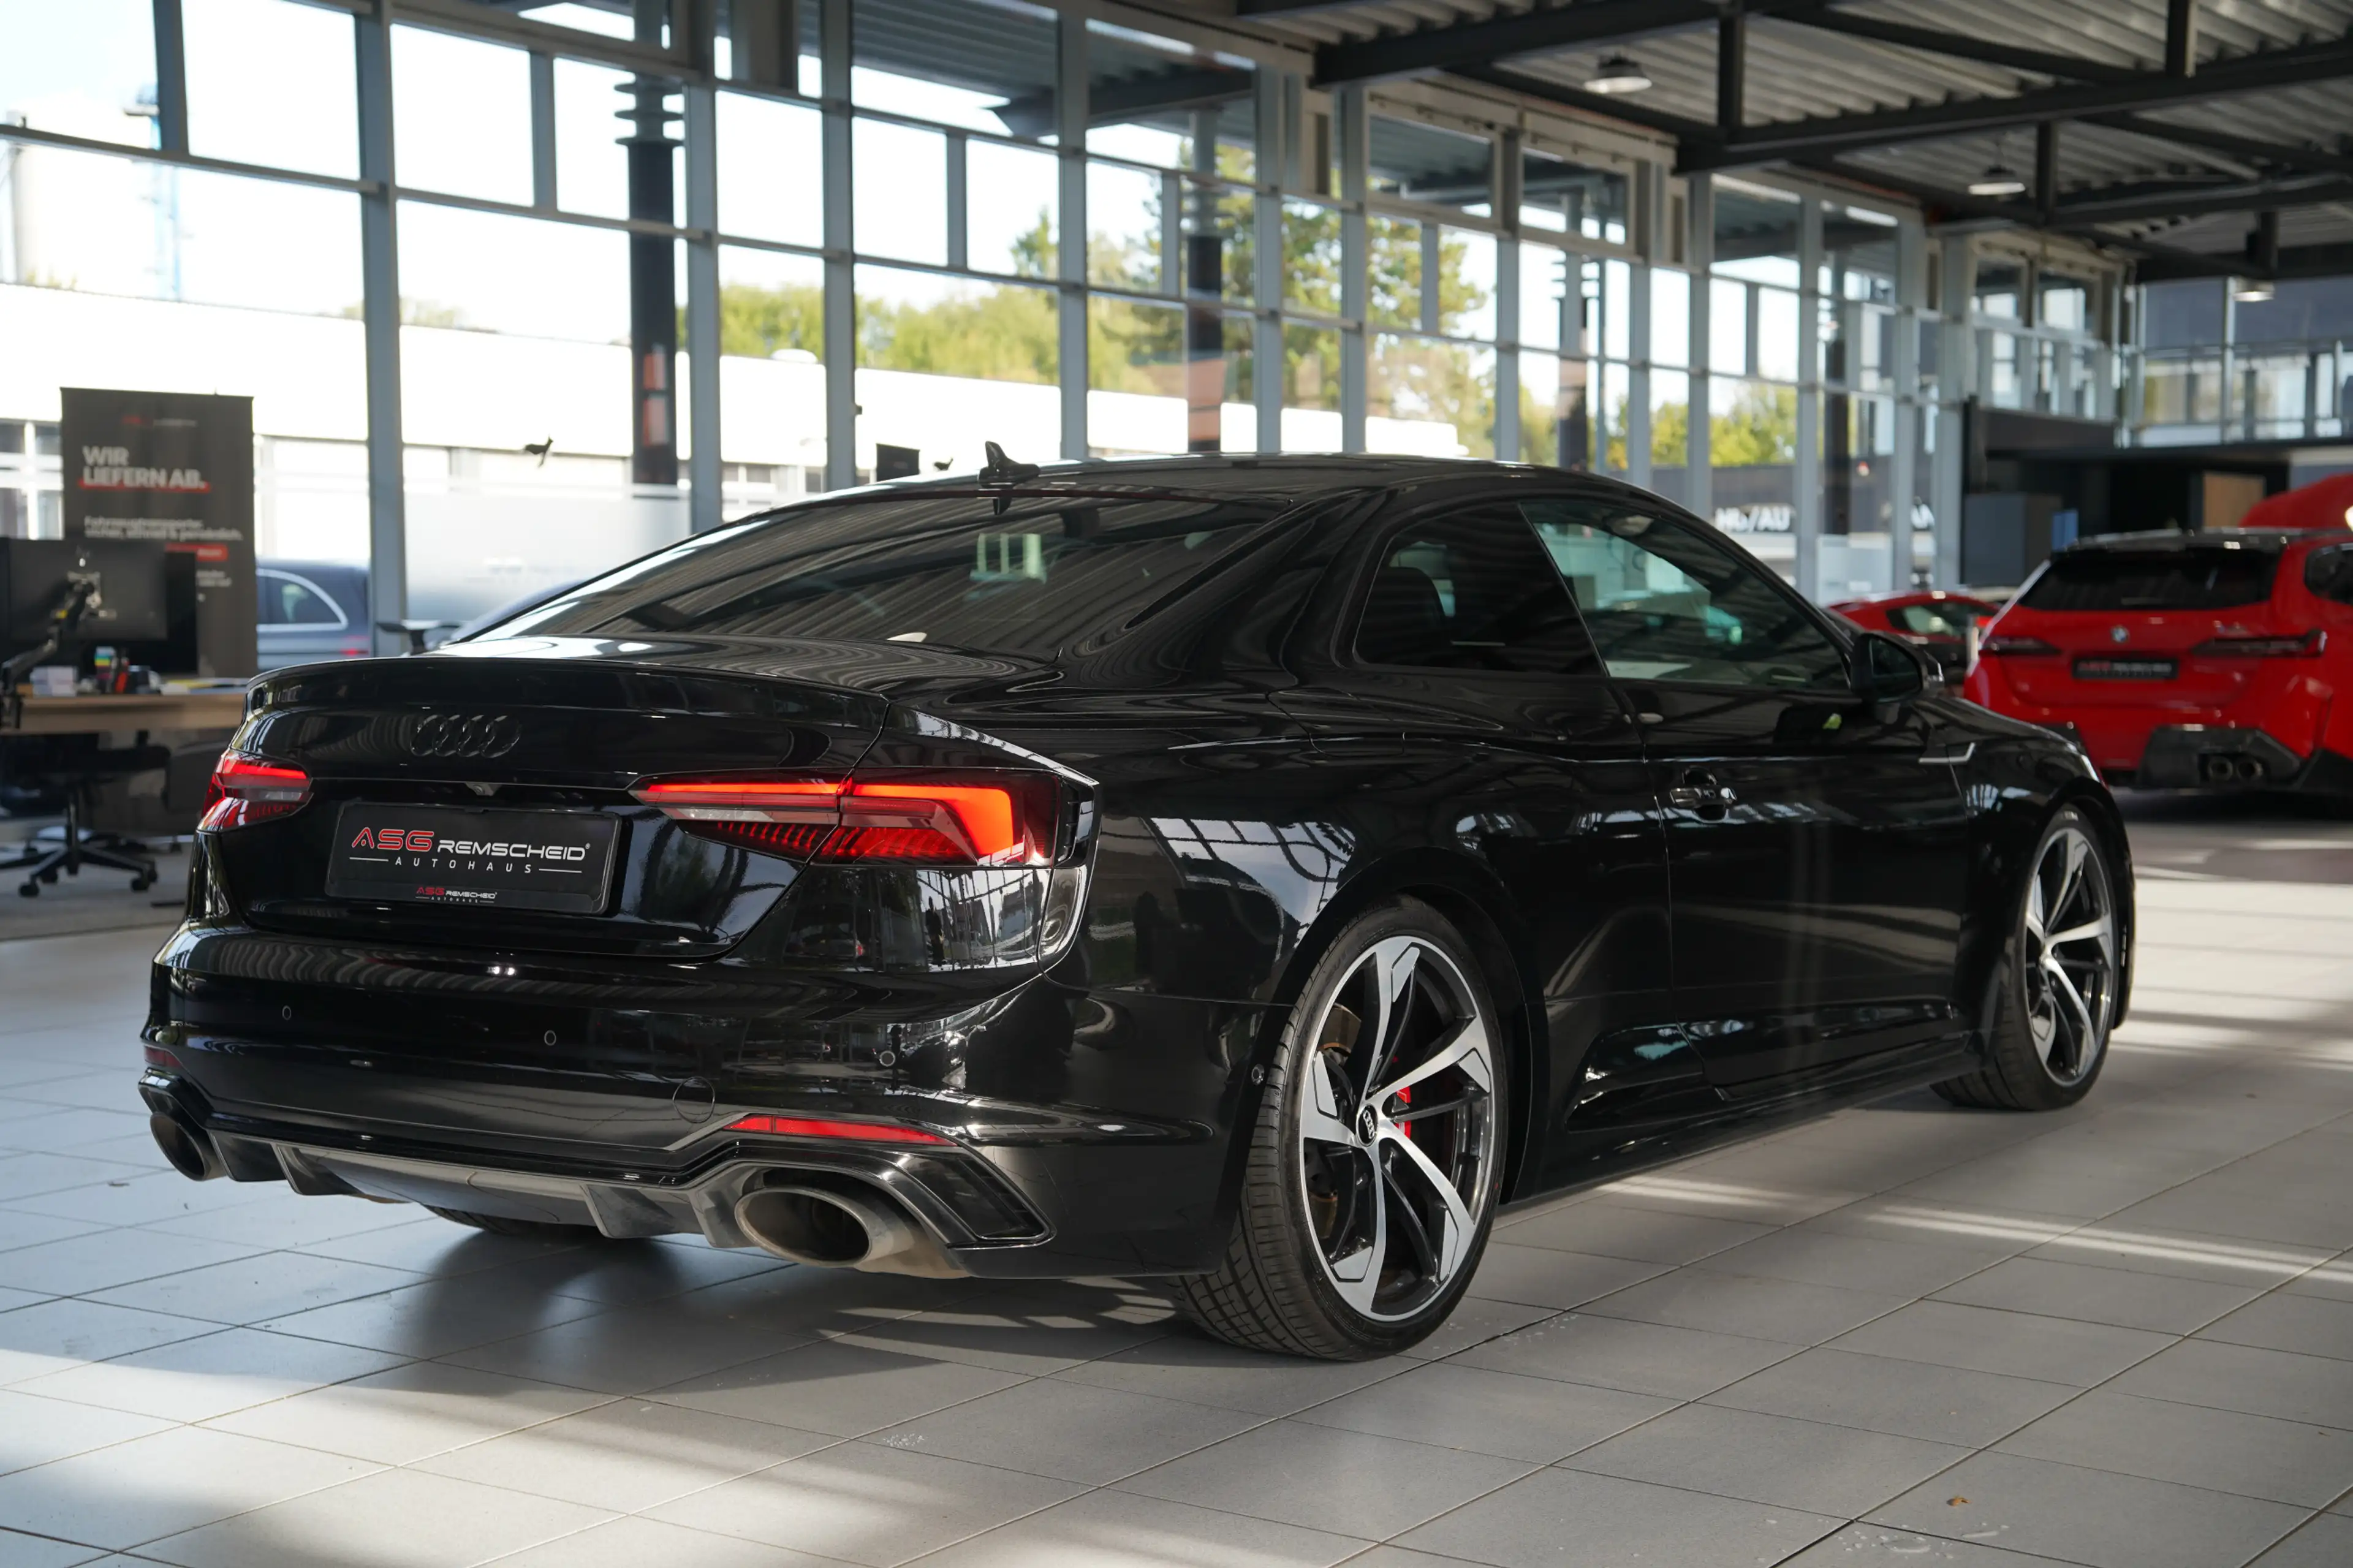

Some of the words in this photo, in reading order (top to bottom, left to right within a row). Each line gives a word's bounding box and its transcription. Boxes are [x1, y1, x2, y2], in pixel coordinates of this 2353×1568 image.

[82, 445, 129, 466] WIR
[83, 466, 167, 488] LIEFERN
[169, 468, 205, 489] AB.
[352, 827, 434, 852] ASG
[395, 857, 531, 873] AUTOHAUS
[417, 887, 445, 896] ASG
